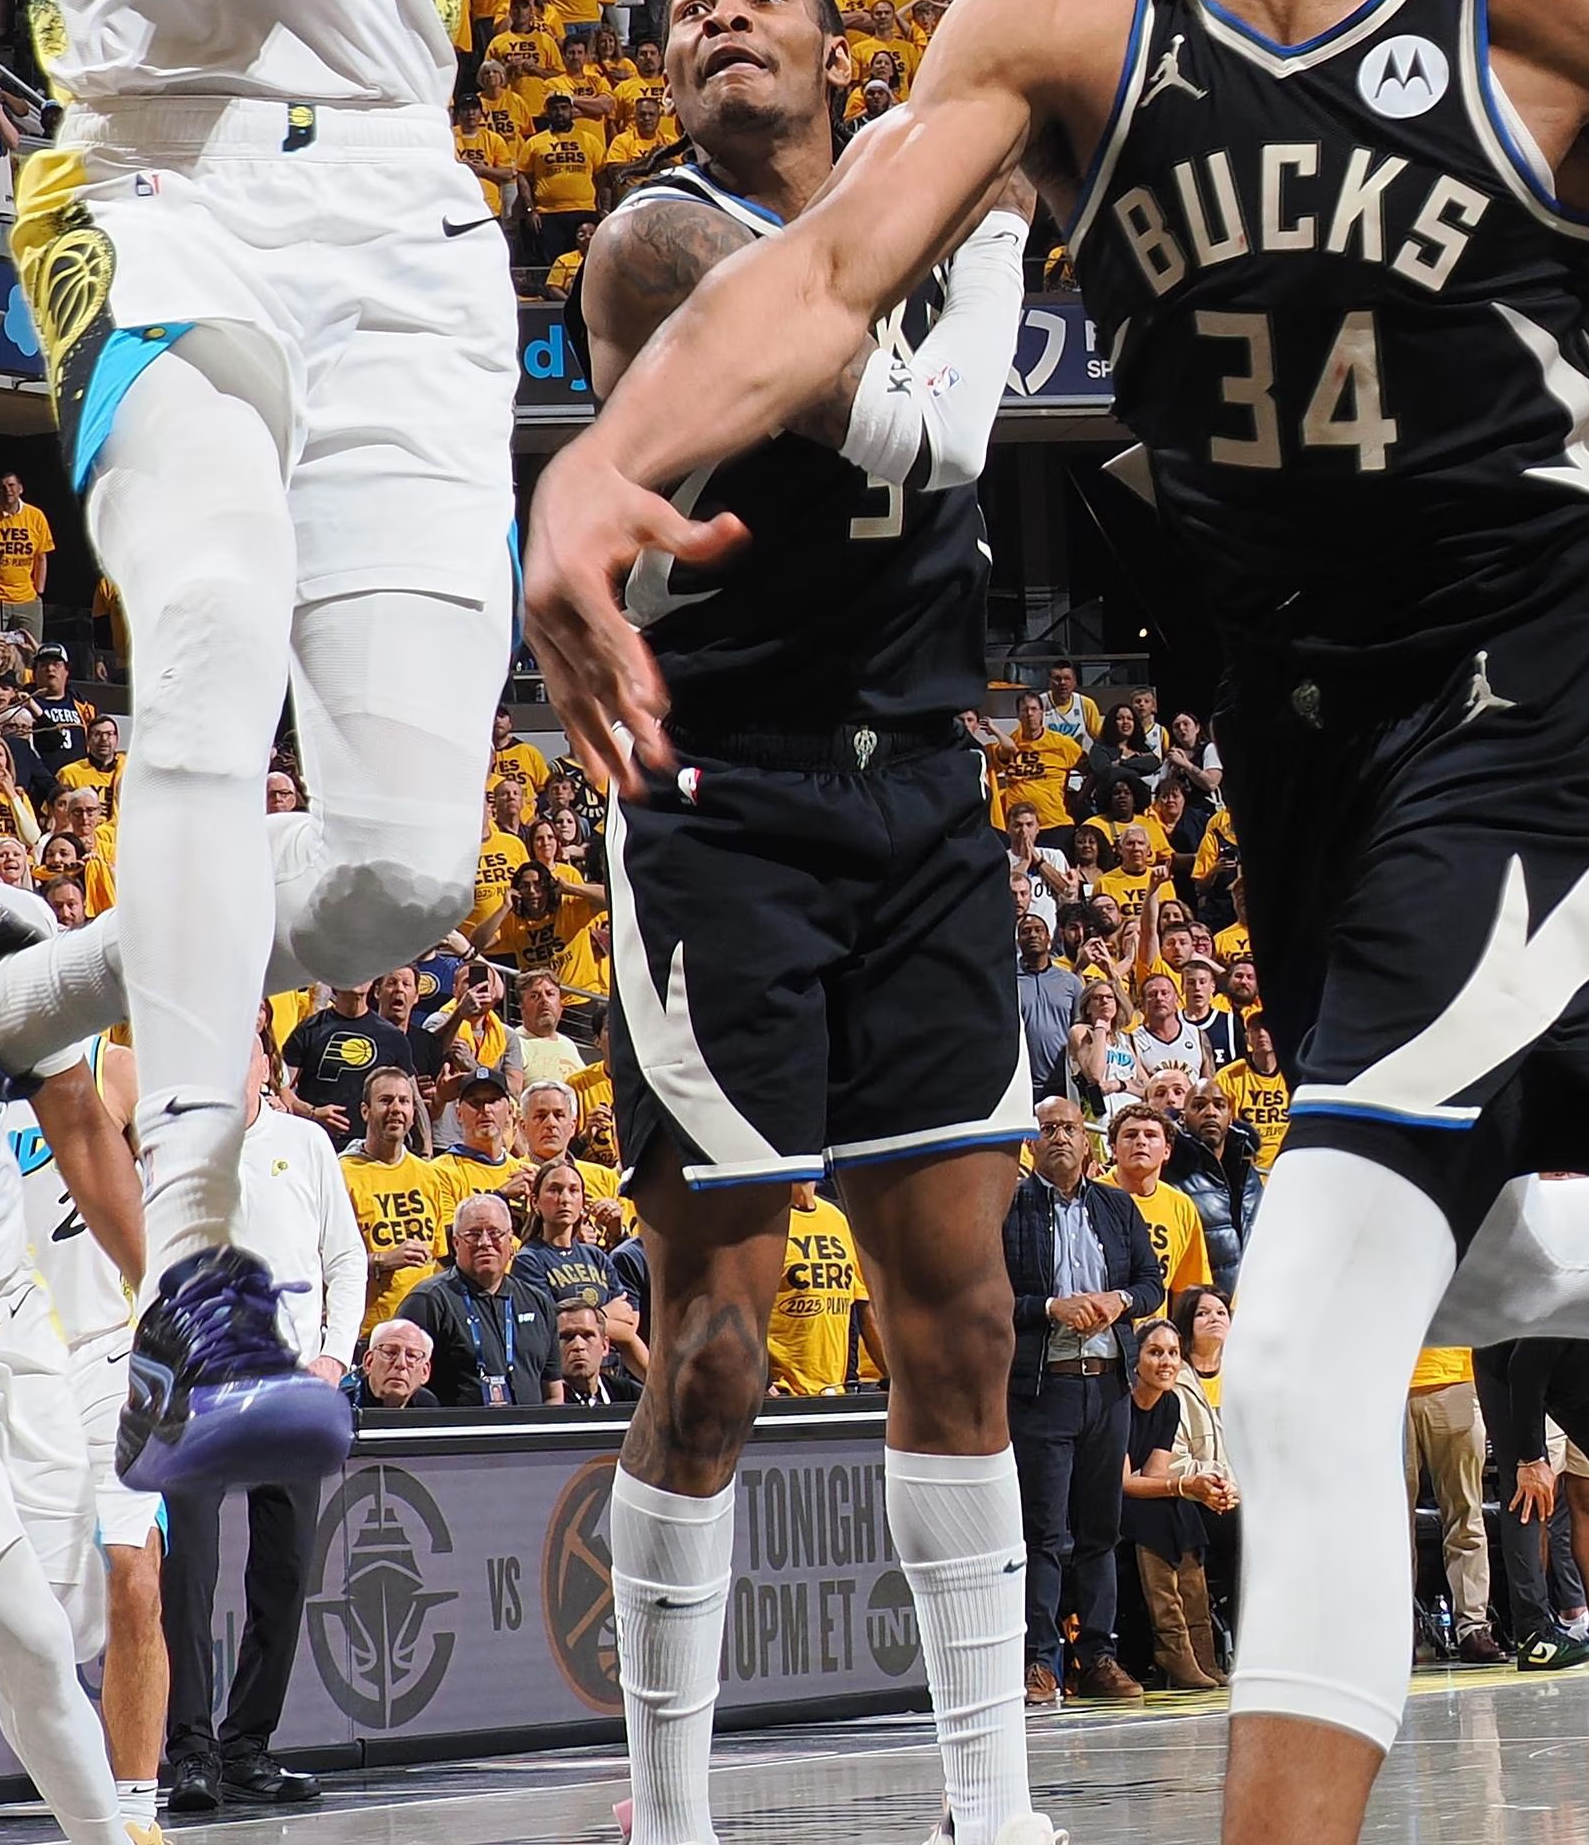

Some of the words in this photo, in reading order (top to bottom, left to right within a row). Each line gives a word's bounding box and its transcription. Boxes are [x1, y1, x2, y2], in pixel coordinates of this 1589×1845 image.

[1113, 144, 1492, 296] BUCKS
[1195, 309, 1398, 471] 34
[373, 1191, 424, 1216] YES
[790, 1235, 847, 1261] YES
[785, 1297, 822, 1314] 2025
[487, 1557, 524, 1631] VS
[721, 1574, 812, 1681] 0PM
[820, 1577, 857, 1674] ET
